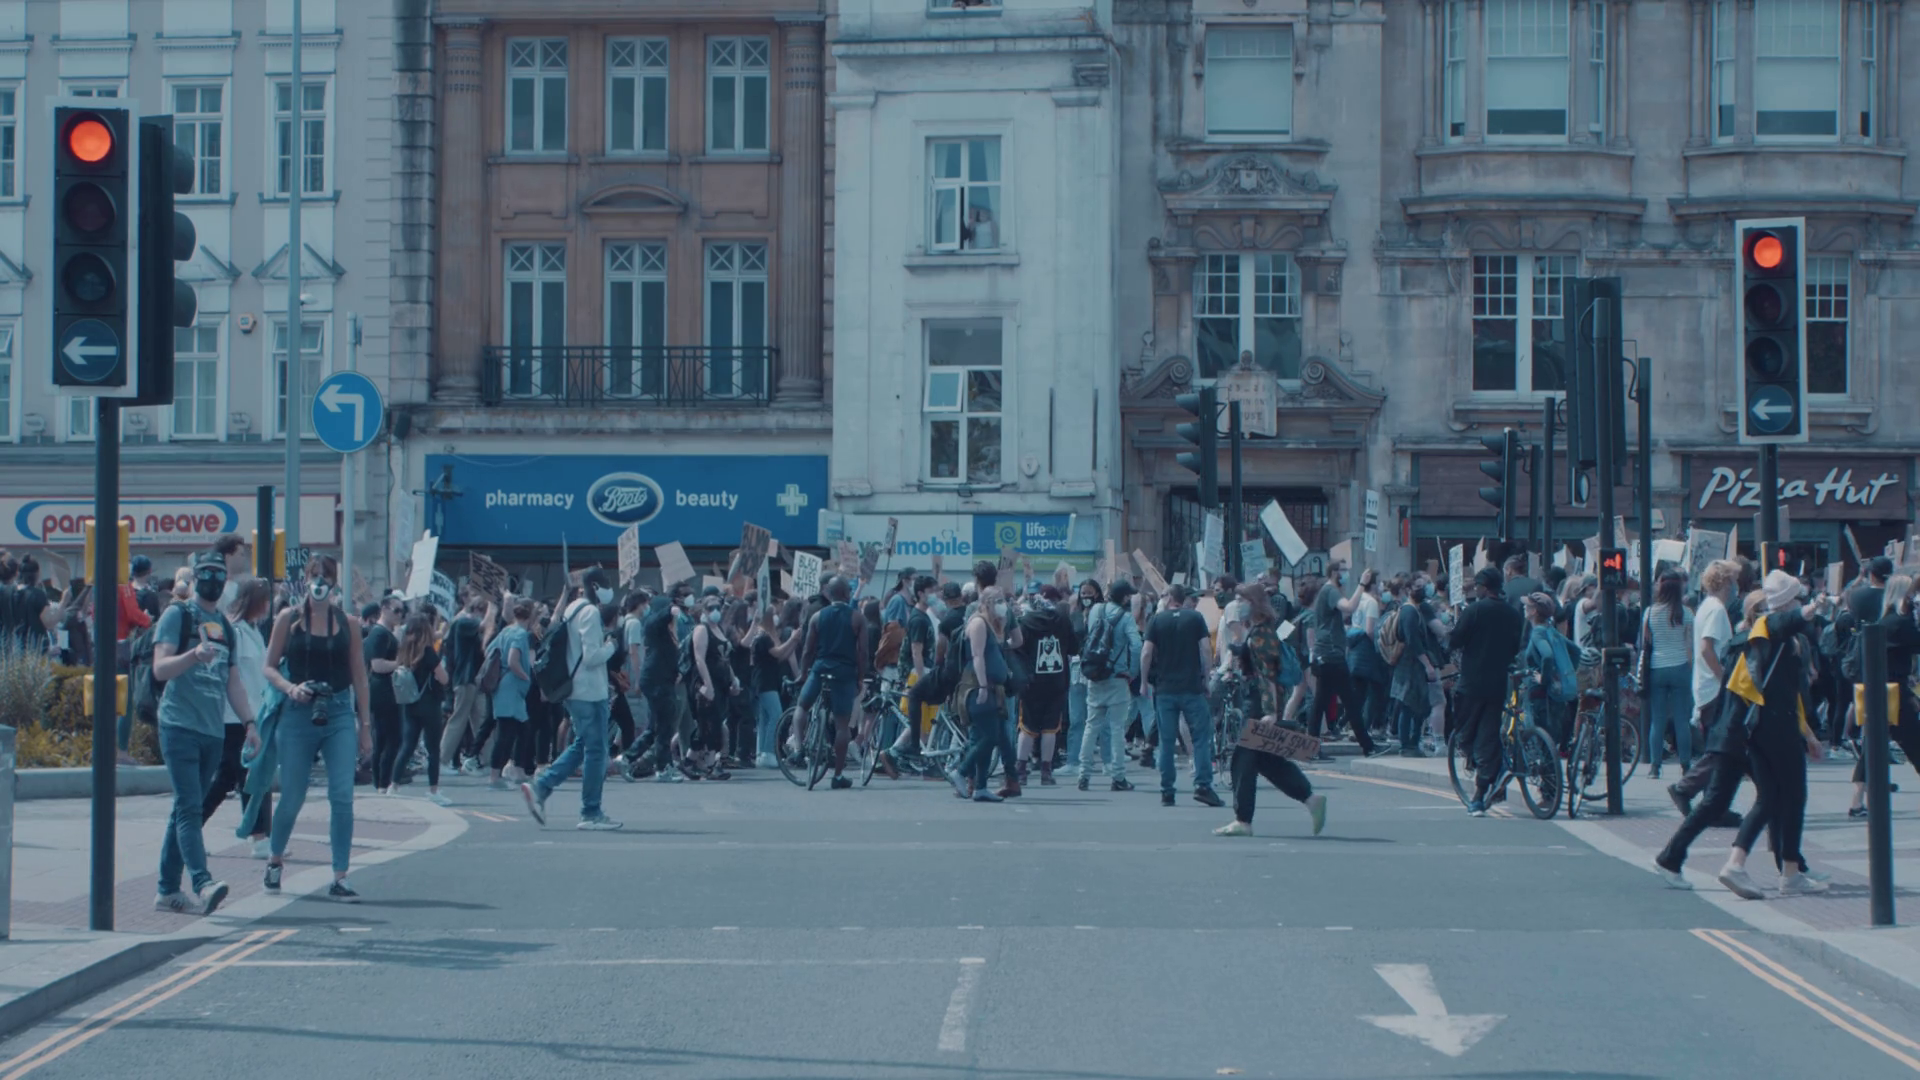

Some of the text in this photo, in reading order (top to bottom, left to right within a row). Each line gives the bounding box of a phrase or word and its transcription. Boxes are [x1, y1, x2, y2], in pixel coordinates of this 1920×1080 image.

[1814, 466, 1900, 506] Hut
[485, 488, 575, 511] pharmacy
[598, 486, 648, 513] Boots
[676, 489, 739, 511] beauty
[144, 514, 221, 534] neave
[1026, 539, 1068, 552] expres
[798, 554, 819, 572] BLACK
[797, 567, 817, 584] LIVES
